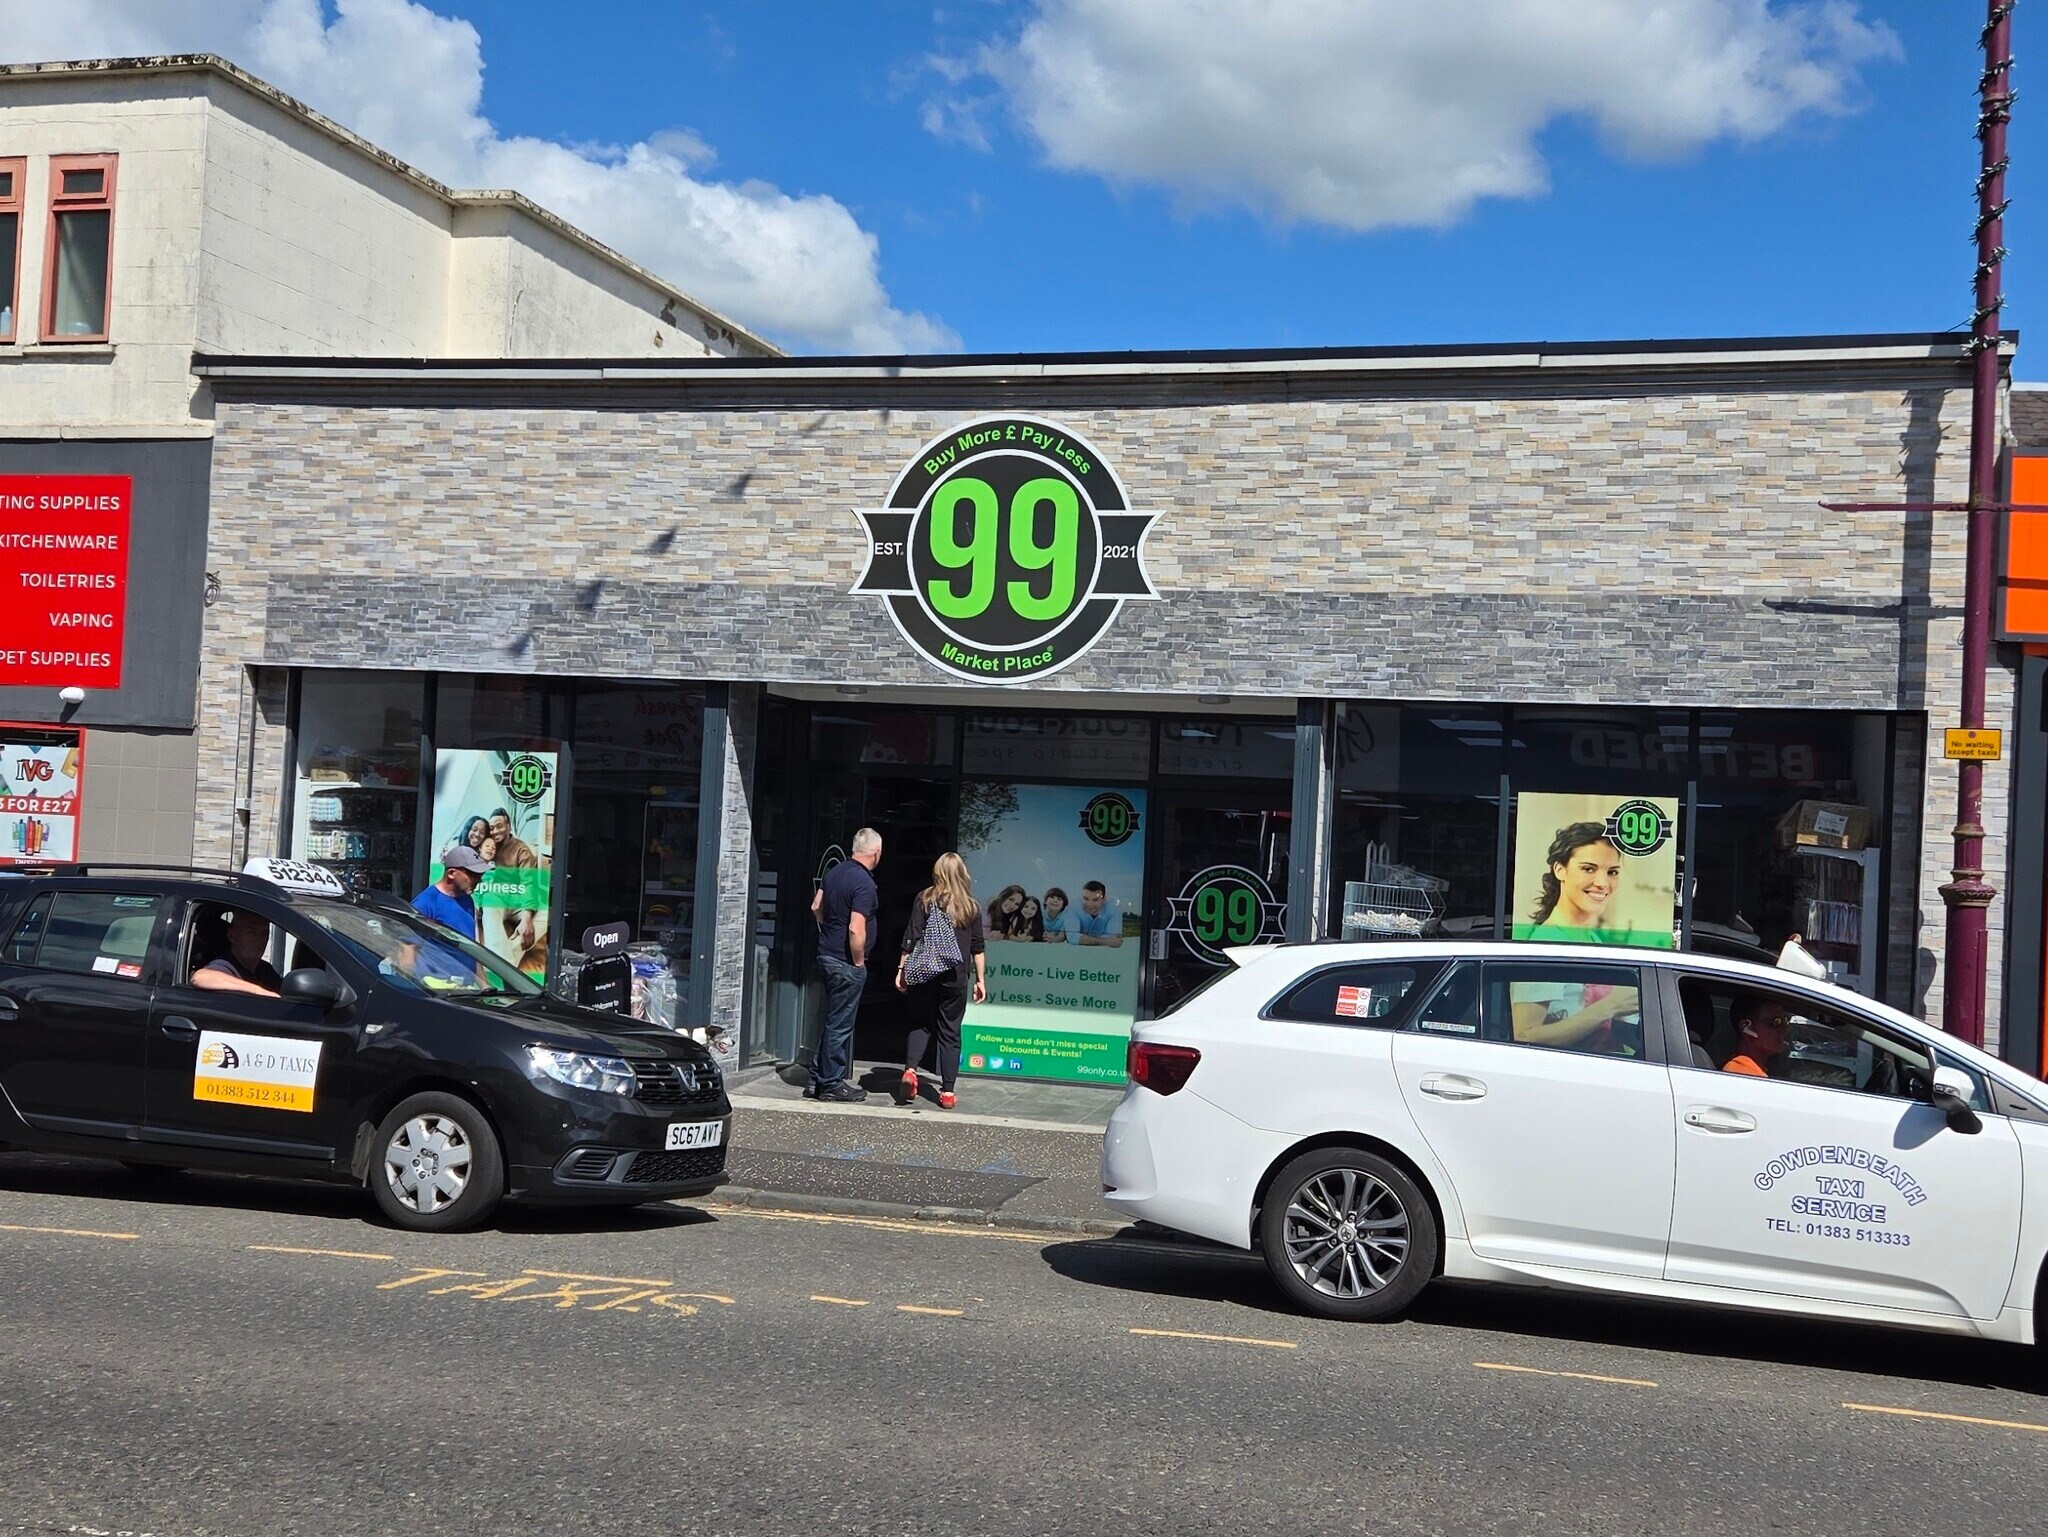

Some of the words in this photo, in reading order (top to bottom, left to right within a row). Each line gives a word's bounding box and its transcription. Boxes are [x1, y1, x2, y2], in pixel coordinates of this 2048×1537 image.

[923, 446, 956, 475] Buy
[957, 428, 1001, 452] More
[1006, 425, 1016, 440] £
[1021, 426, 1054, 450] Pay
[1054, 438, 1091, 475] Less
[40, 496, 120, 510] SUPPLIES
[0, 534, 118, 550] KITCHENWARE
[874, 542, 904, 556] EST.
[927, 477, 1079, 621] 99
[1103, 545, 1136, 559] 2021
[20, 573, 116, 589] TOILETRIES
[49, 612, 113, 628] VAPING
[0, 651, 26, 665] PET
[31, 651, 111, 667] SUPPLIES
[940, 642, 999, 671] Market
[1965, 741, 1995, 749] waiting
[16, 759, 54, 782] IVG
[513, 765, 541, 793] 99
[7, 798, 39, 812] FOR
[42, 800, 72, 813] £27
[1093, 804, 1126, 835] 99
[1621, 812, 1657, 845] 99
[268, 865, 338, 888] 512344
[474, 882, 526, 895] piness
[1196, 887, 1256, 944] 99
[593, 932, 619, 948] Open
[1001, 964, 1034, 978] More
[1047, 967, 1075, 981] Live
[1079, 969, 1122, 984] Better
[1001, 991, 1032, 1004] Less
[1045, 993, 1078, 1007] Save
[1082, 996, 1117, 1009] More
[975, 1033, 1003, 1043] Follow
[1016, 1037, 1032, 1045] and
[1033, 1038, 1055, 1047] don't
[1056, 1040, 1077, 1048] miss
[1078, 1042, 1108, 1051] special
[999, 1045, 1041, 1055] Discounts
[1042, 1048, 1049, 1056] &
[1051, 1049, 1082, 1058] Events!
[242, 1053, 251, 1067] A
[254, 1054, 263, 1069] &
[266, 1055, 275, 1069] D
[280, 1056, 315, 1073] TAXIS
[1077, 1065, 1126, 1078] 99only.co.u
[206, 1084, 243, 1098] 01383
[246, 1087, 270, 1101] 512
[273, 1091, 295, 1104] 344
[672, 1126, 701, 1145] SC67
[701, 1123, 719, 1143] AVT
[1754, 1146, 1927, 1207] COWDENBEATH
[1816, 1176, 1865, 1199] TAXI
[1791, 1195, 1886, 1224] SERVICE
[1766, 1218, 1801, 1234] TEL:
[1806, 1223, 1851, 1239] 01383
[1856, 1229, 1911, 1247] 513333
